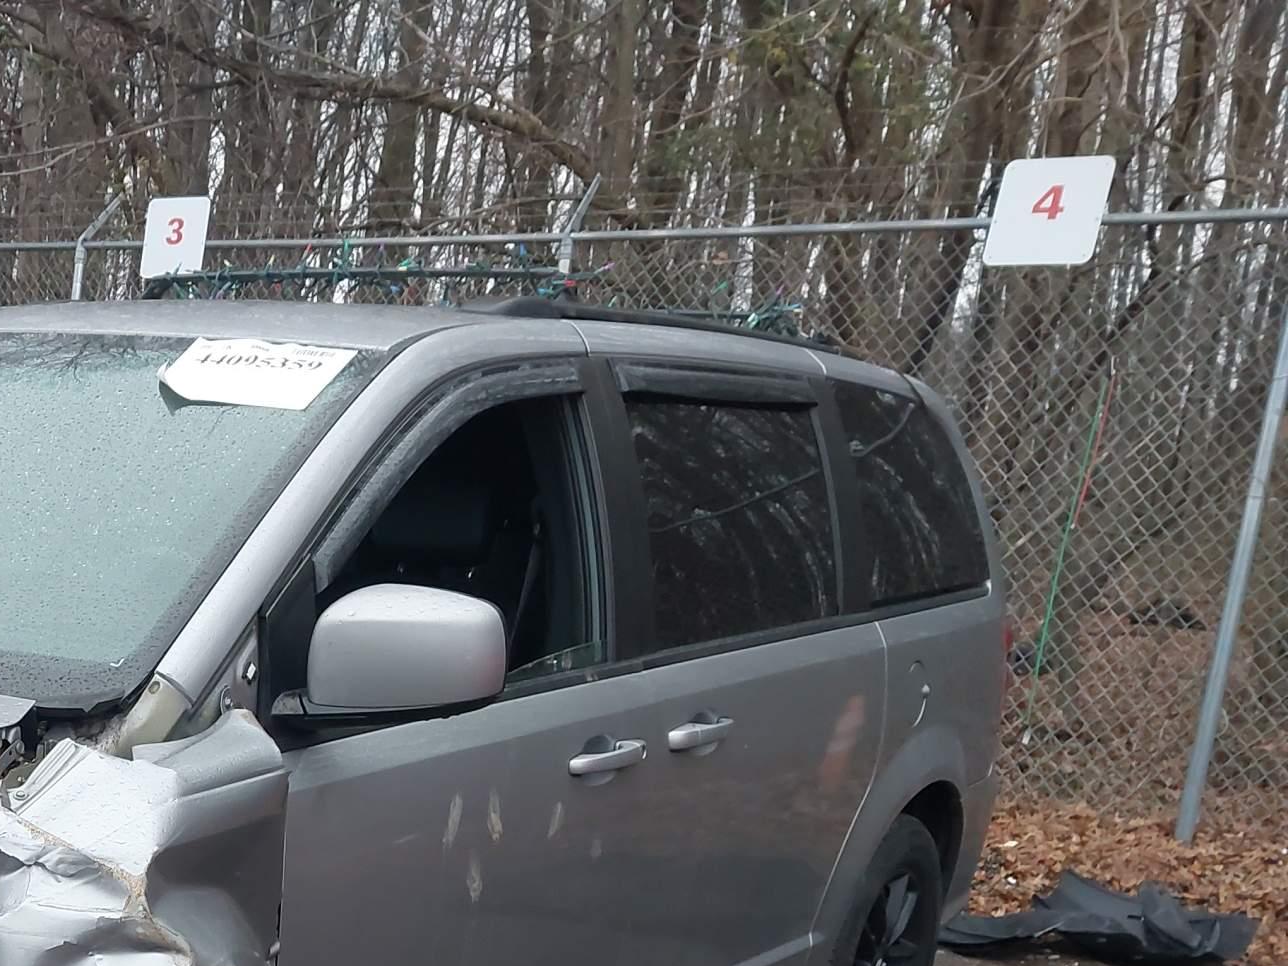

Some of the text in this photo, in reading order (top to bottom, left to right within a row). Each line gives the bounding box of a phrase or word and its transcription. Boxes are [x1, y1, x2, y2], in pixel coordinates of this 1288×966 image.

[1031, 184, 1064, 220] 4
[165, 217, 185, 246] 3
[196, 353, 323, 371] 44095359
